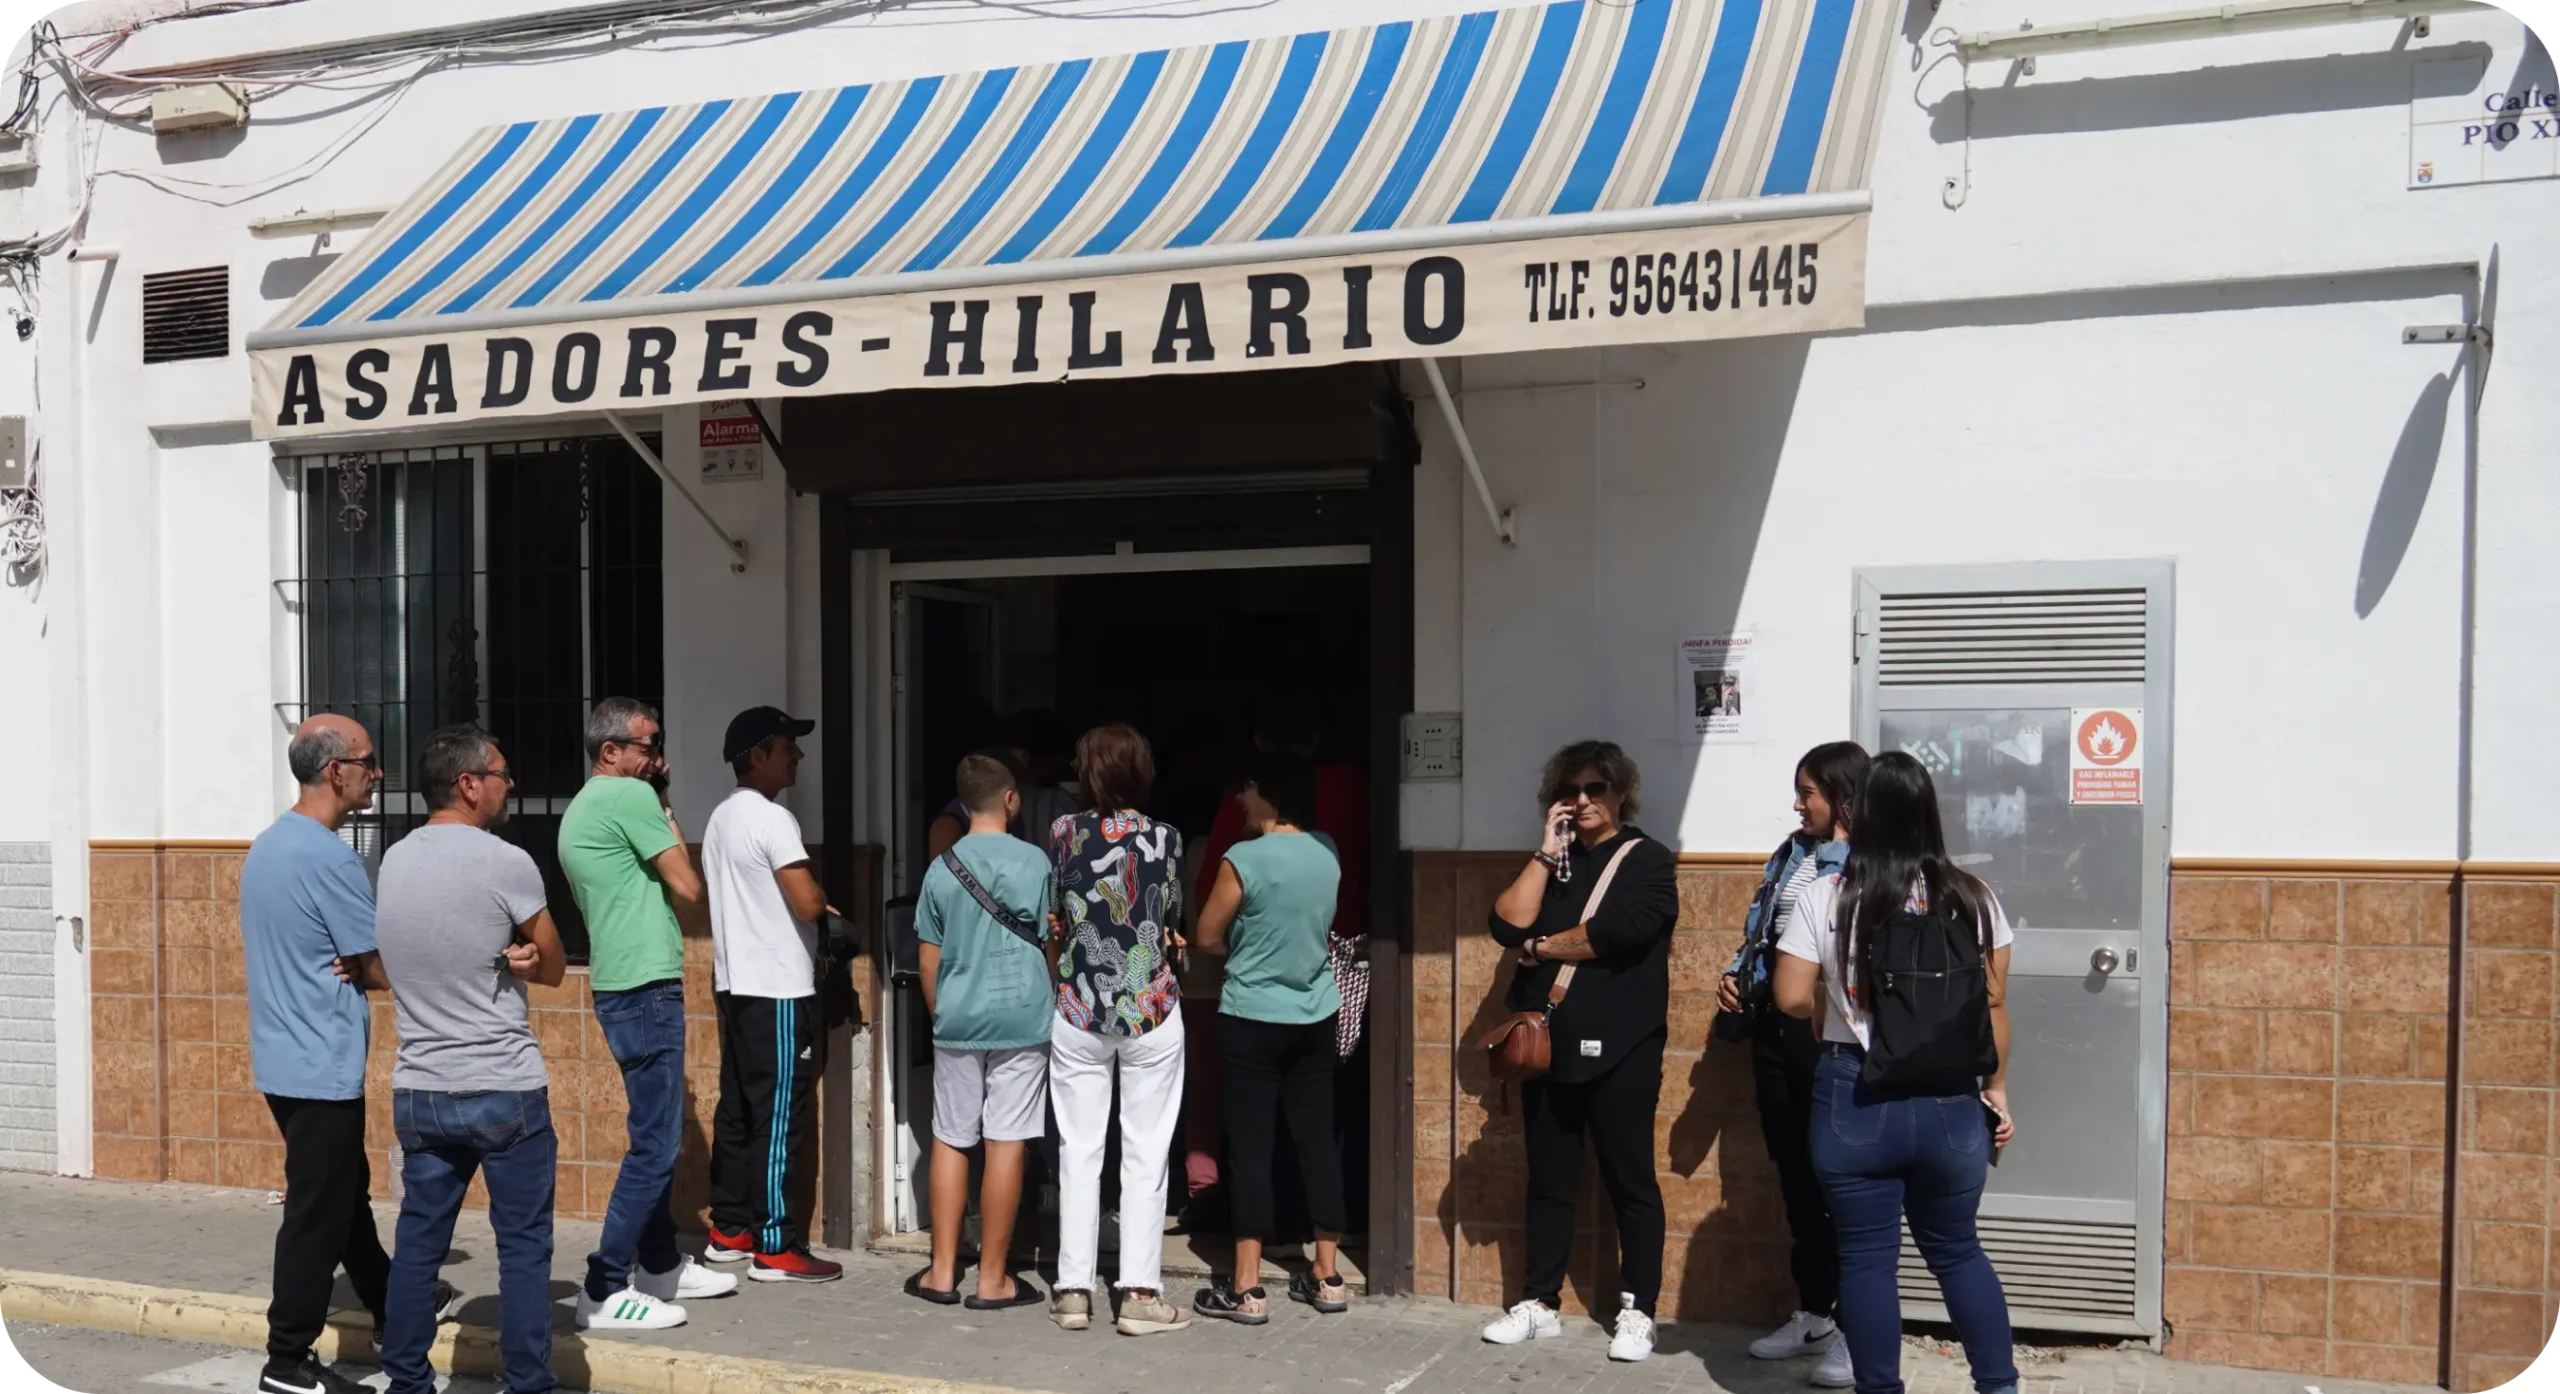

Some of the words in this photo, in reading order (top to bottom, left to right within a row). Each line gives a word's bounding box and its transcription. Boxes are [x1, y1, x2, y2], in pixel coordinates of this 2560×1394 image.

[2485, 89, 2558, 112] Calle
[2462, 121, 2520, 145] PIO
[277, 310, 834, 426] ASADORES
[923, 255, 1466, 377] HILARIO
[1525, 260, 1595, 322] TLF.
[1609, 243, 1819, 318] 956431445
[703, 422, 760, 437] Alarma
[2079, 771, 2092, 779] GAS
